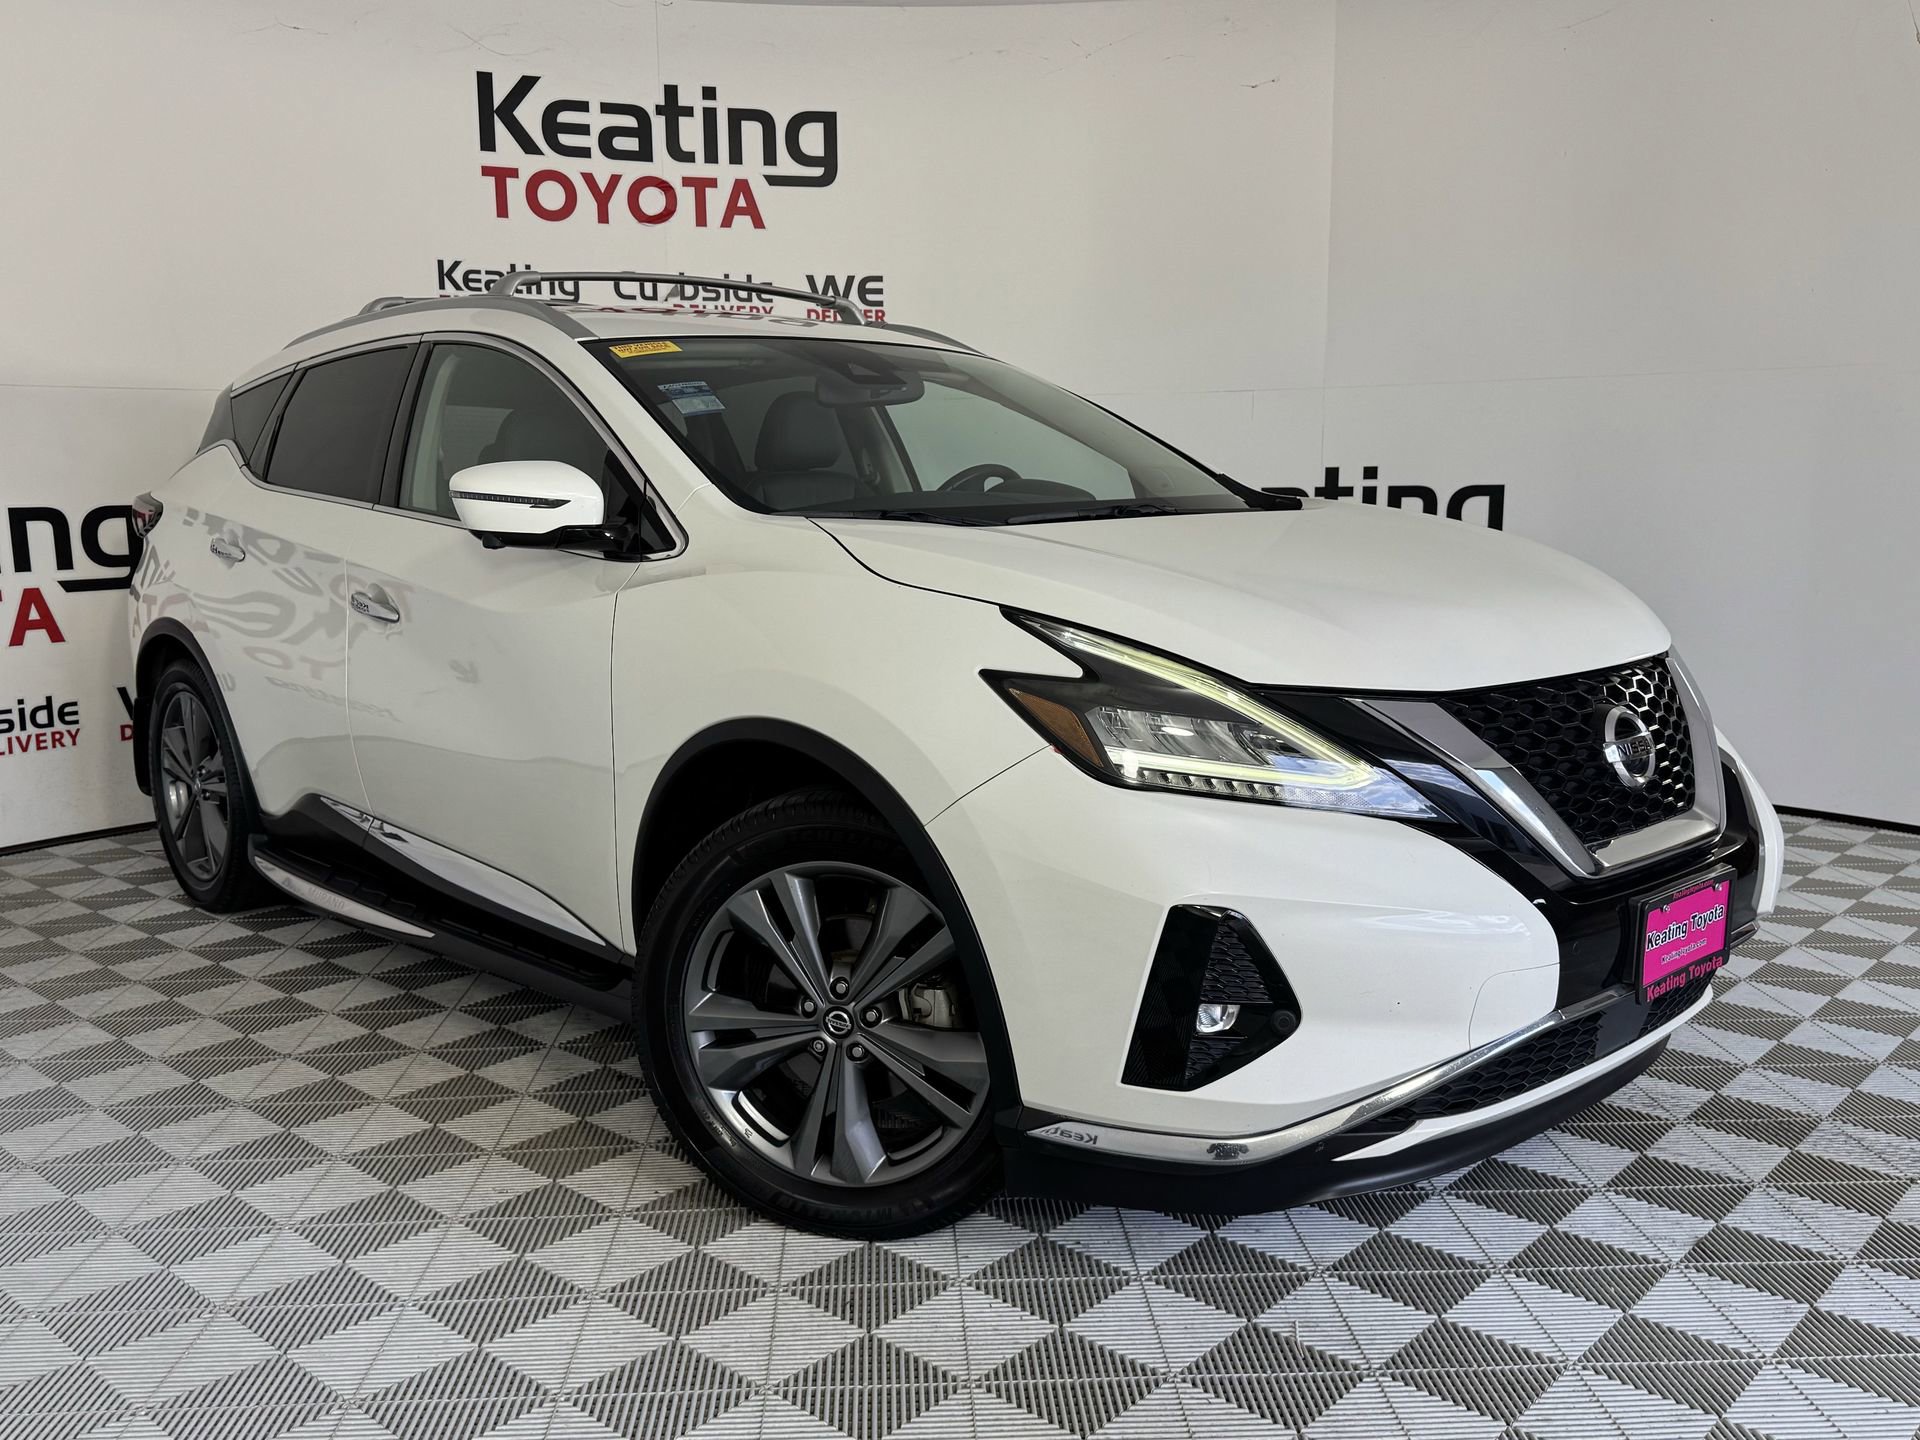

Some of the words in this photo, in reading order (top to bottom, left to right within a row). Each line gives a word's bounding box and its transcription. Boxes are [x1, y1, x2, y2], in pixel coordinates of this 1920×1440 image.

[476, 71, 838, 188] Keating
[481, 165, 767, 229] TOYOTA
[806, 275, 884, 307] WE
[7, 505, 146, 592] ng
[9, 588, 66, 646] A
[1646, 920, 1688, 951] Keating
[1690, 904, 1724, 931] Toyota
[1647, 972, 1686, 1002] Keating
[1688, 956, 1723, 979] Toyota
